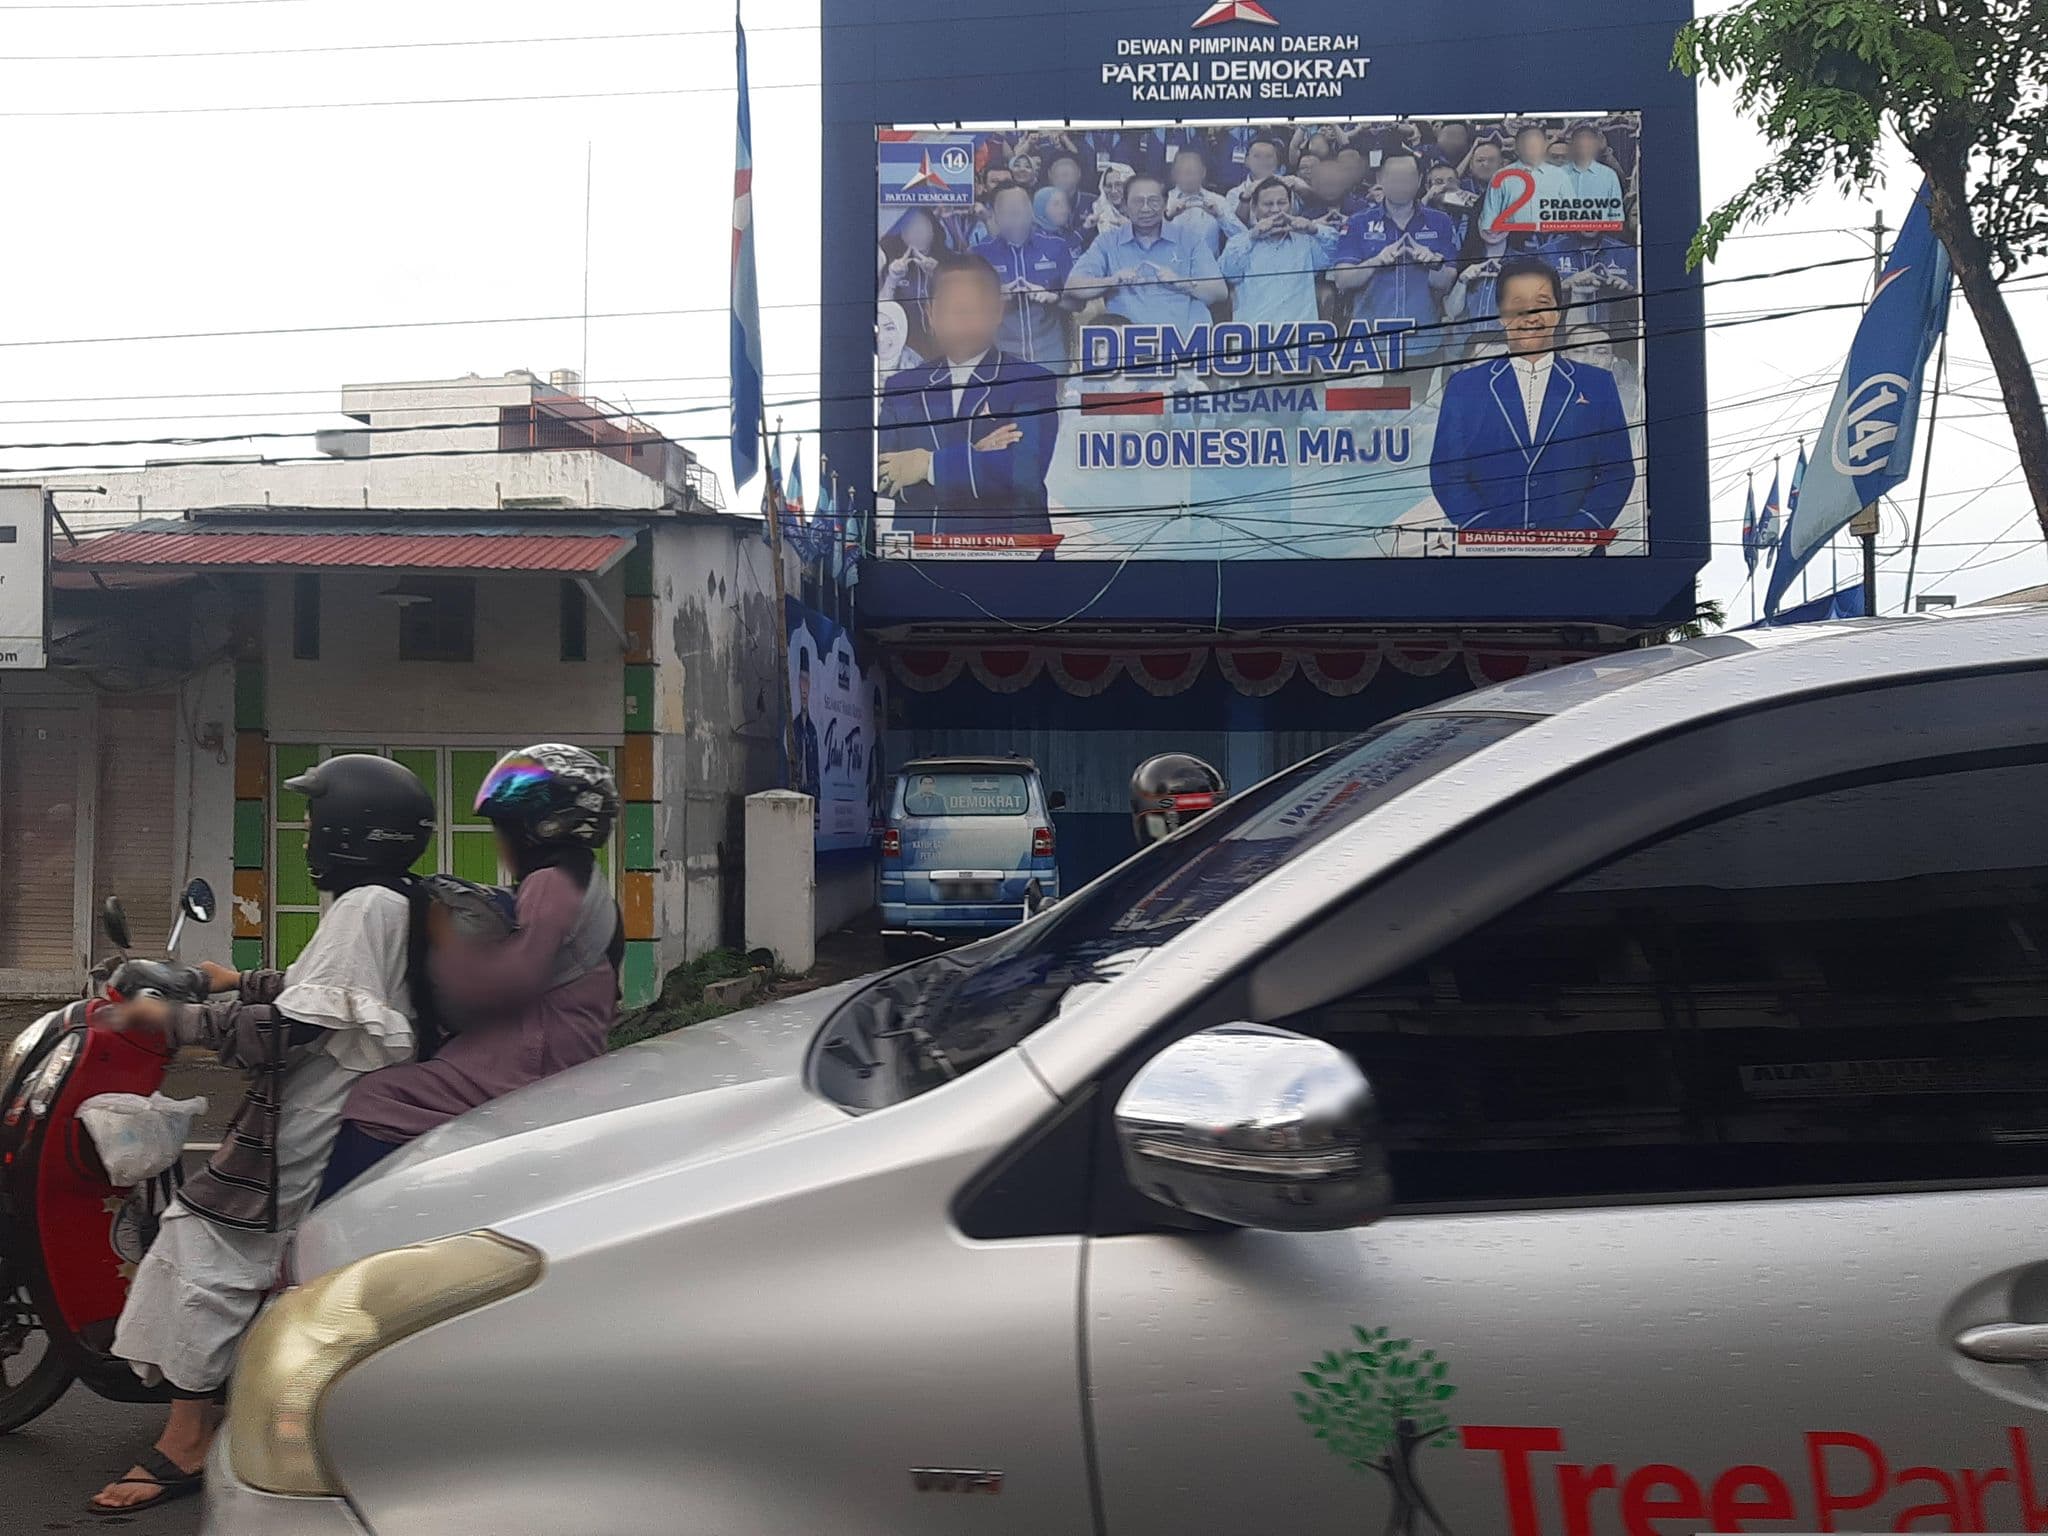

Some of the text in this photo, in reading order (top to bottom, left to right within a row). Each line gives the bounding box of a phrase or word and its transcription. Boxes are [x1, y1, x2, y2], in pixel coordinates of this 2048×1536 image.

[1117, 35, 1359, 56] DEWAN PIMPINAN DAERAH
[1101, 58, 1371, 84] PARTAI DEMOKRAT
[1132, 81, 1342, 101] KALIMANTAN SELATAN
[945, 152, 965, 169] 14
[885, 193, 968, 202] PARTAI DEMOKRAT
[1490, 168, 1537, 233] 2
[1539, 198, 1621, 210] PRABOWO
[1539, 210, 1602, 221] GIBRAN
[1080, 318, 1416, 379] DEMOKRAT
[1173, 387, 1319, 415] BERSAMA
[1077, 426, 1412, 469] INDONESIA MAJU
[985, 536, 1016, 548] SINA
[1465, 531, 1537, 543] BAMBANG
[1540, 530, 1586, 543] YANTO
[949, 795, 1022, 809] DEMOKRAT
